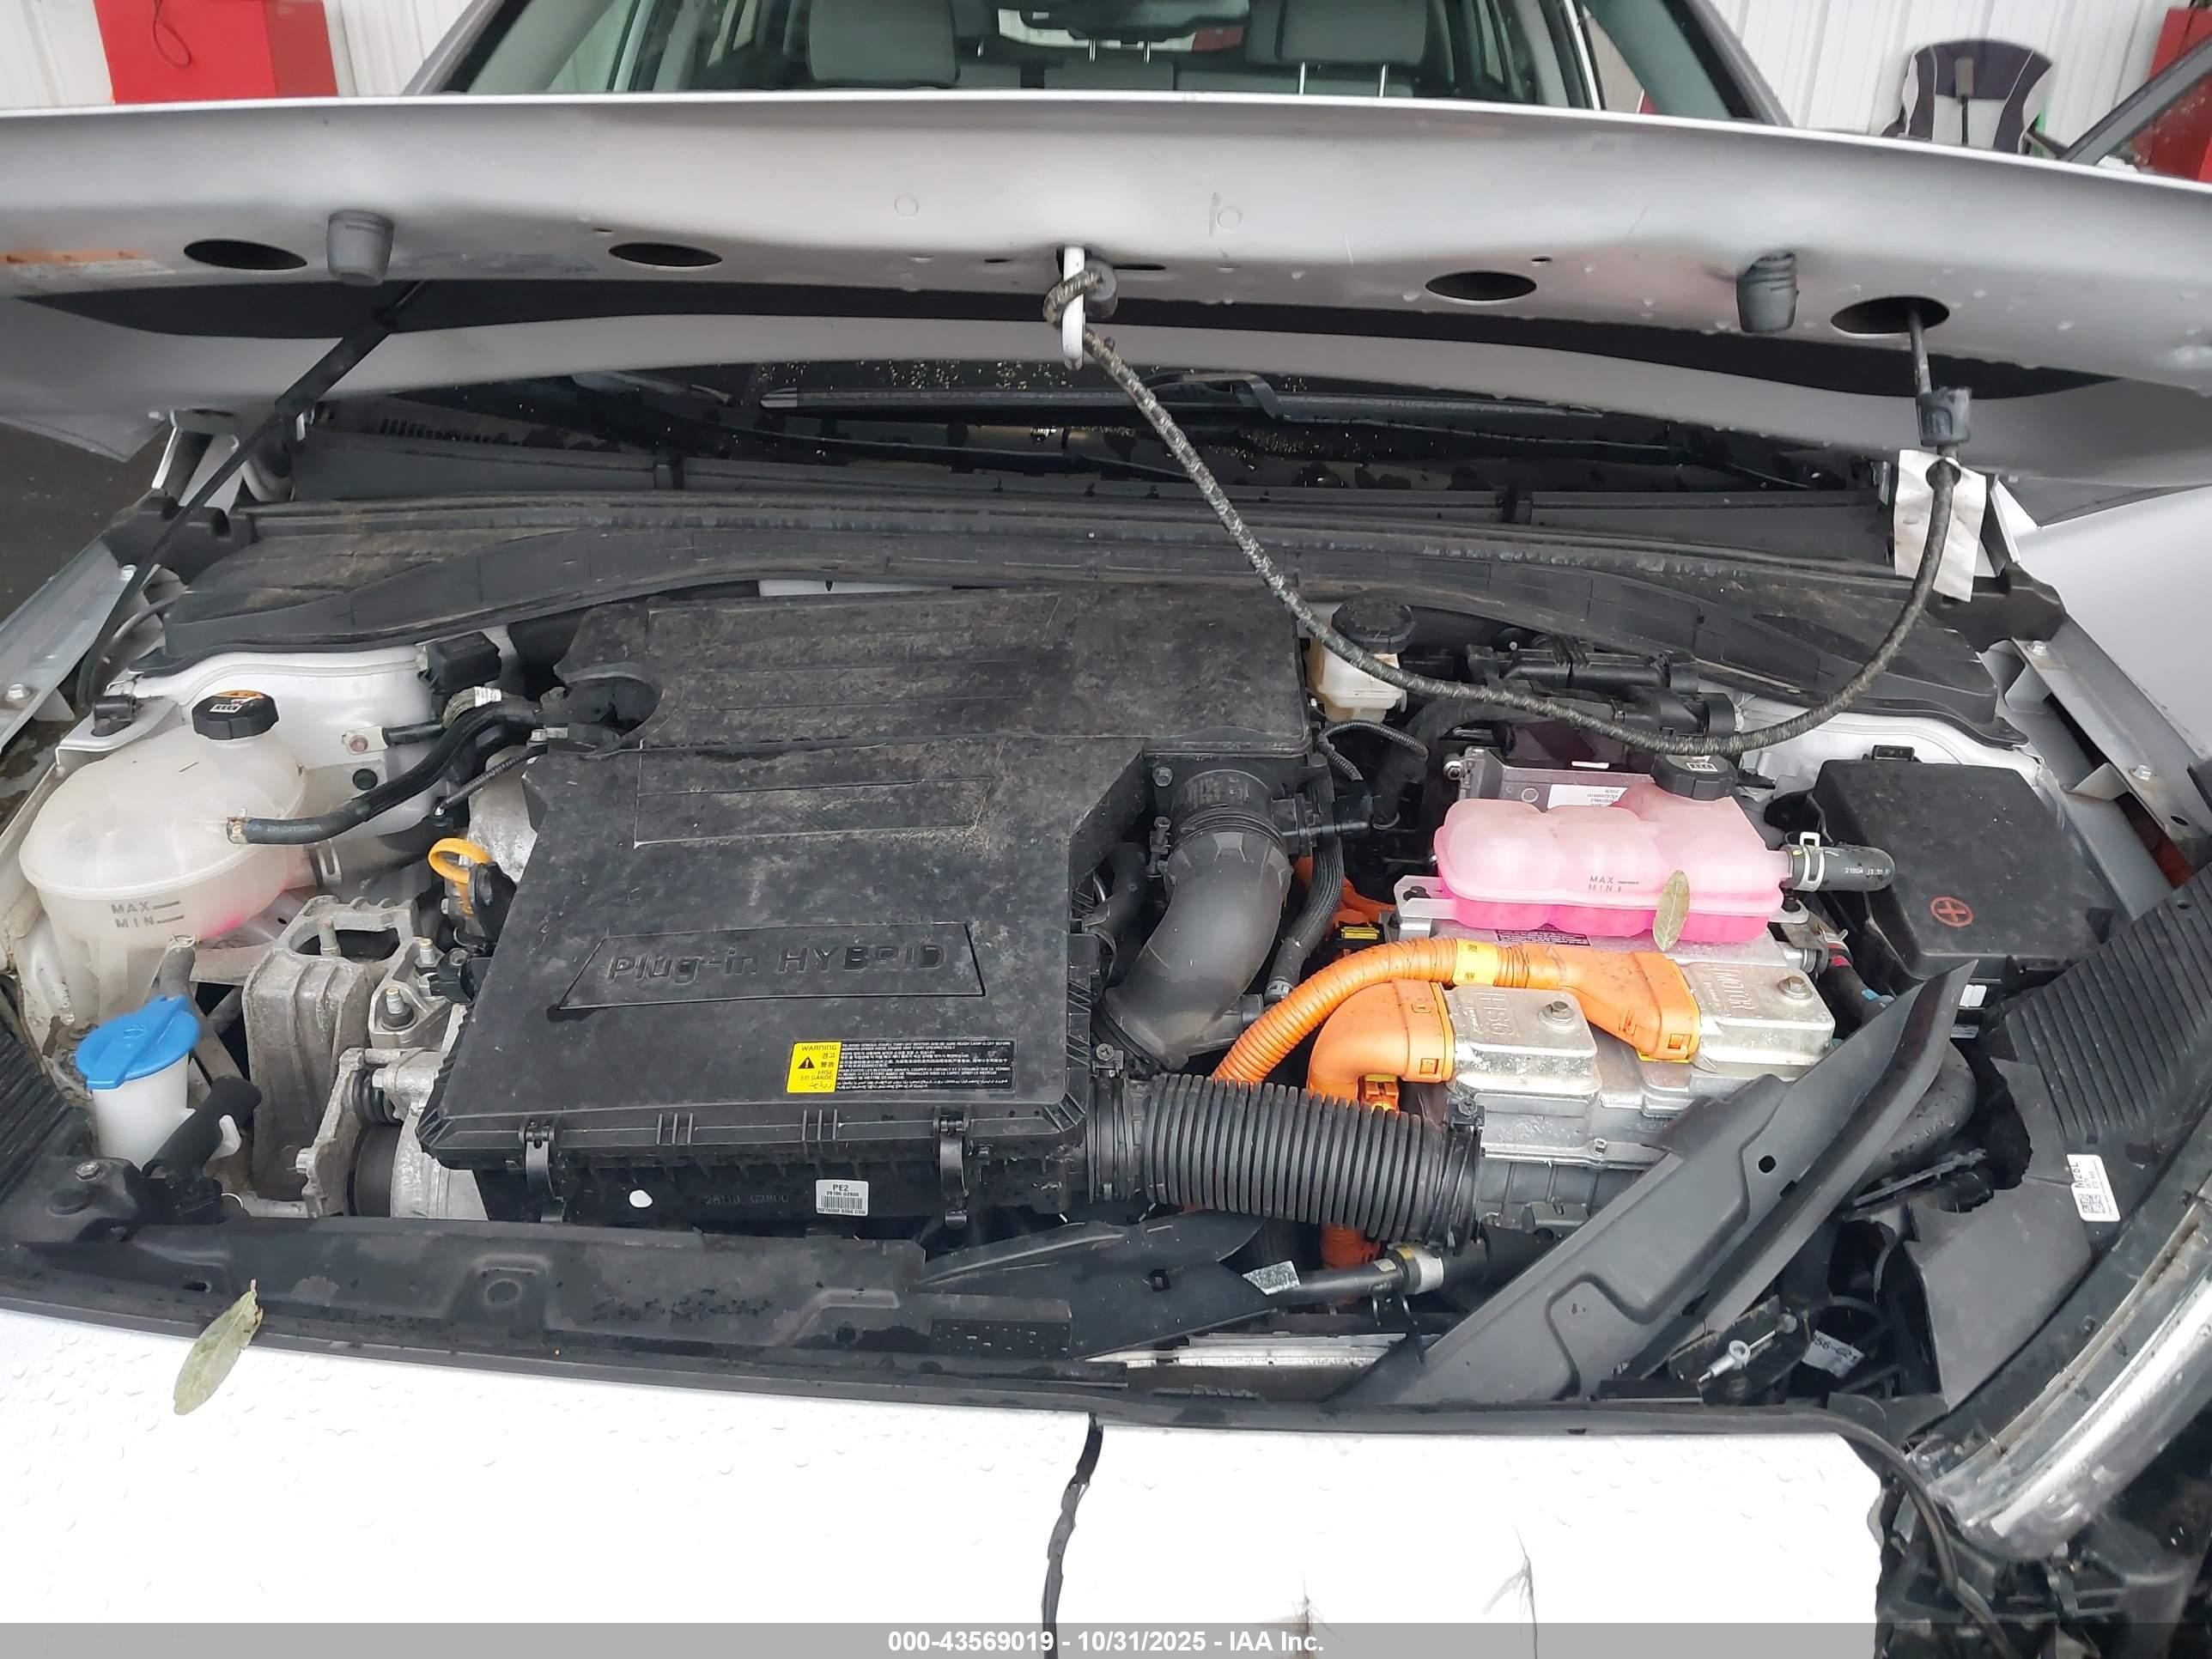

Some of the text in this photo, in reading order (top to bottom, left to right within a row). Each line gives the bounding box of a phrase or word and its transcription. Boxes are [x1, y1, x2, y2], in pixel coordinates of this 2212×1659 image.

[1589, 875, 1613, 884] MAX
[111, 901, 149, 915] MAX
[115, 915, 155, 928] MIN
[607, 945, 945, 984] Plug-in HYBRID
